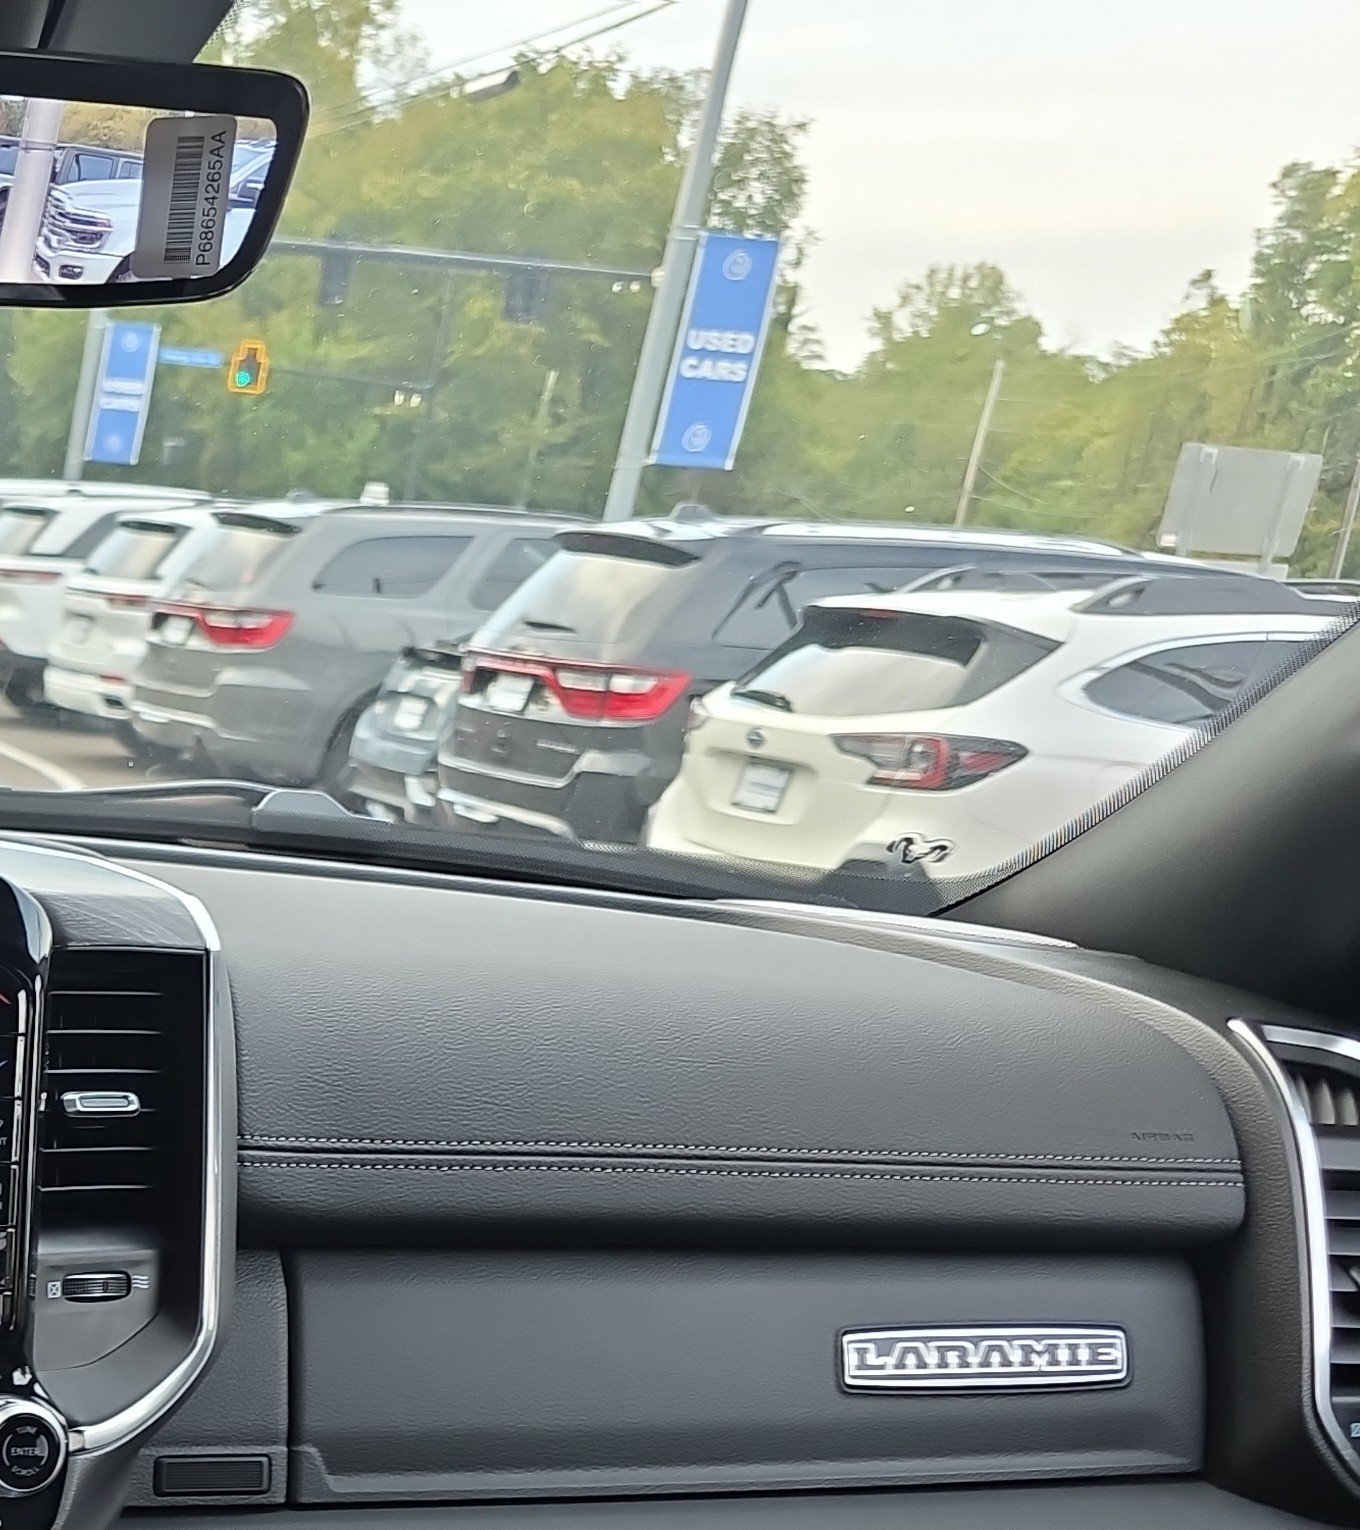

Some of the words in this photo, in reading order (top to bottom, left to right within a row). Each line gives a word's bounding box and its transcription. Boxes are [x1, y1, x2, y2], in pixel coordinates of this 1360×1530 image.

[195, 130, 227, 267] P68654265AA
[686, 329, 755, 355] USED
[680, 356, 749, 383] CARS
[846, 1337, 1123, 1376] LARAMIE
[15, 1425, 38, 1435] TUNE
[10, 1446, 40, 1457] ENTER
